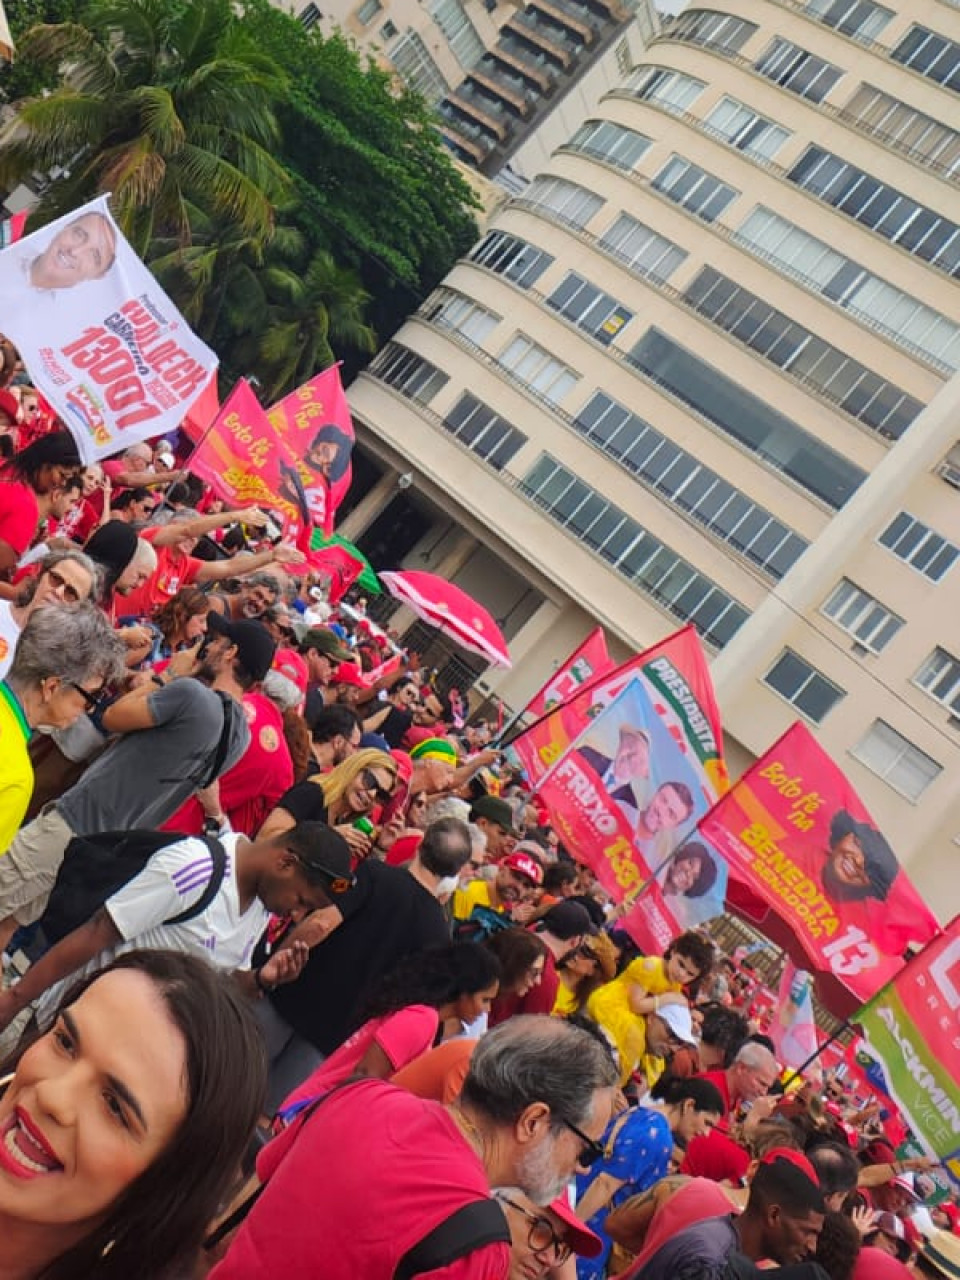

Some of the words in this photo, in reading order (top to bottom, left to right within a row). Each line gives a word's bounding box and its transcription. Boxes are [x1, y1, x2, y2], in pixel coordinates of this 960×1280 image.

[60, 325, 163, 431] 13001
[648, 657, 719, 754] PRESIDENTE
[759, 761, 802, 799] Boto
[792, 790, 826, 817] fé
[787, 810, 815, 833] na
[739, 822, 840, 938] BENEDITA
[751, 859, 824, 940] SENADORA
[820, 923, 880, 976] 13
[912, 1092, 954, 1143] VICE
